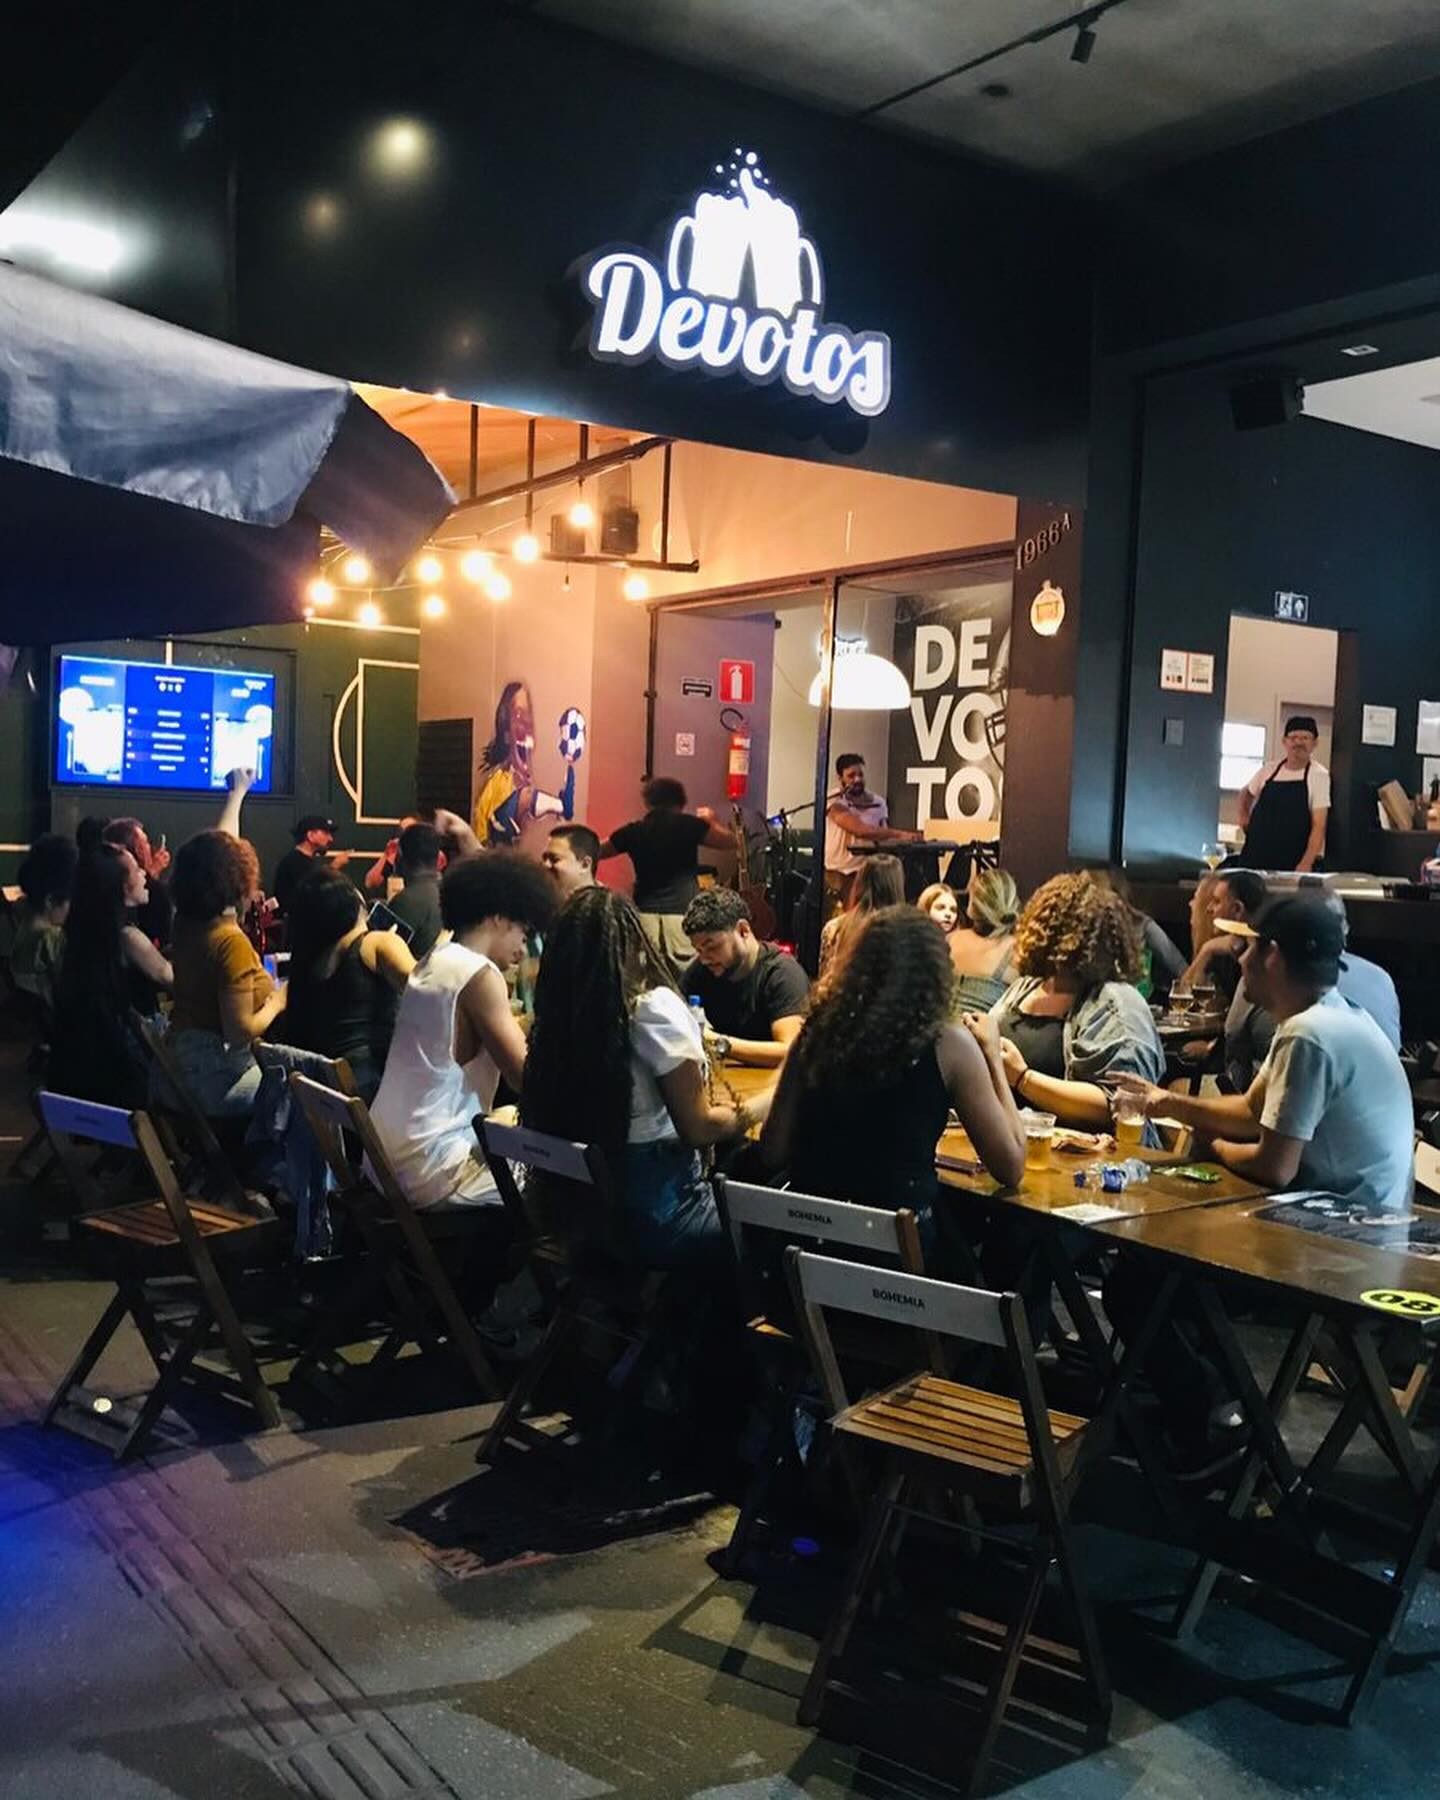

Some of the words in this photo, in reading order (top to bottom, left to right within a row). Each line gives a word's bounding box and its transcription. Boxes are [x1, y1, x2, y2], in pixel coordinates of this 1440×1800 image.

[588, 253, 884, 407] Devotos
[914, 618, 992, 691] DE
[910, 692, 998, 762] VO
[906, 766, 1003, 831] TO
[787, 1209, 833, 1225] BOHEMIA
[872, 1288, 925, 1309] BOHEMIA
[1370, 1293, 1439, 1311] 08
